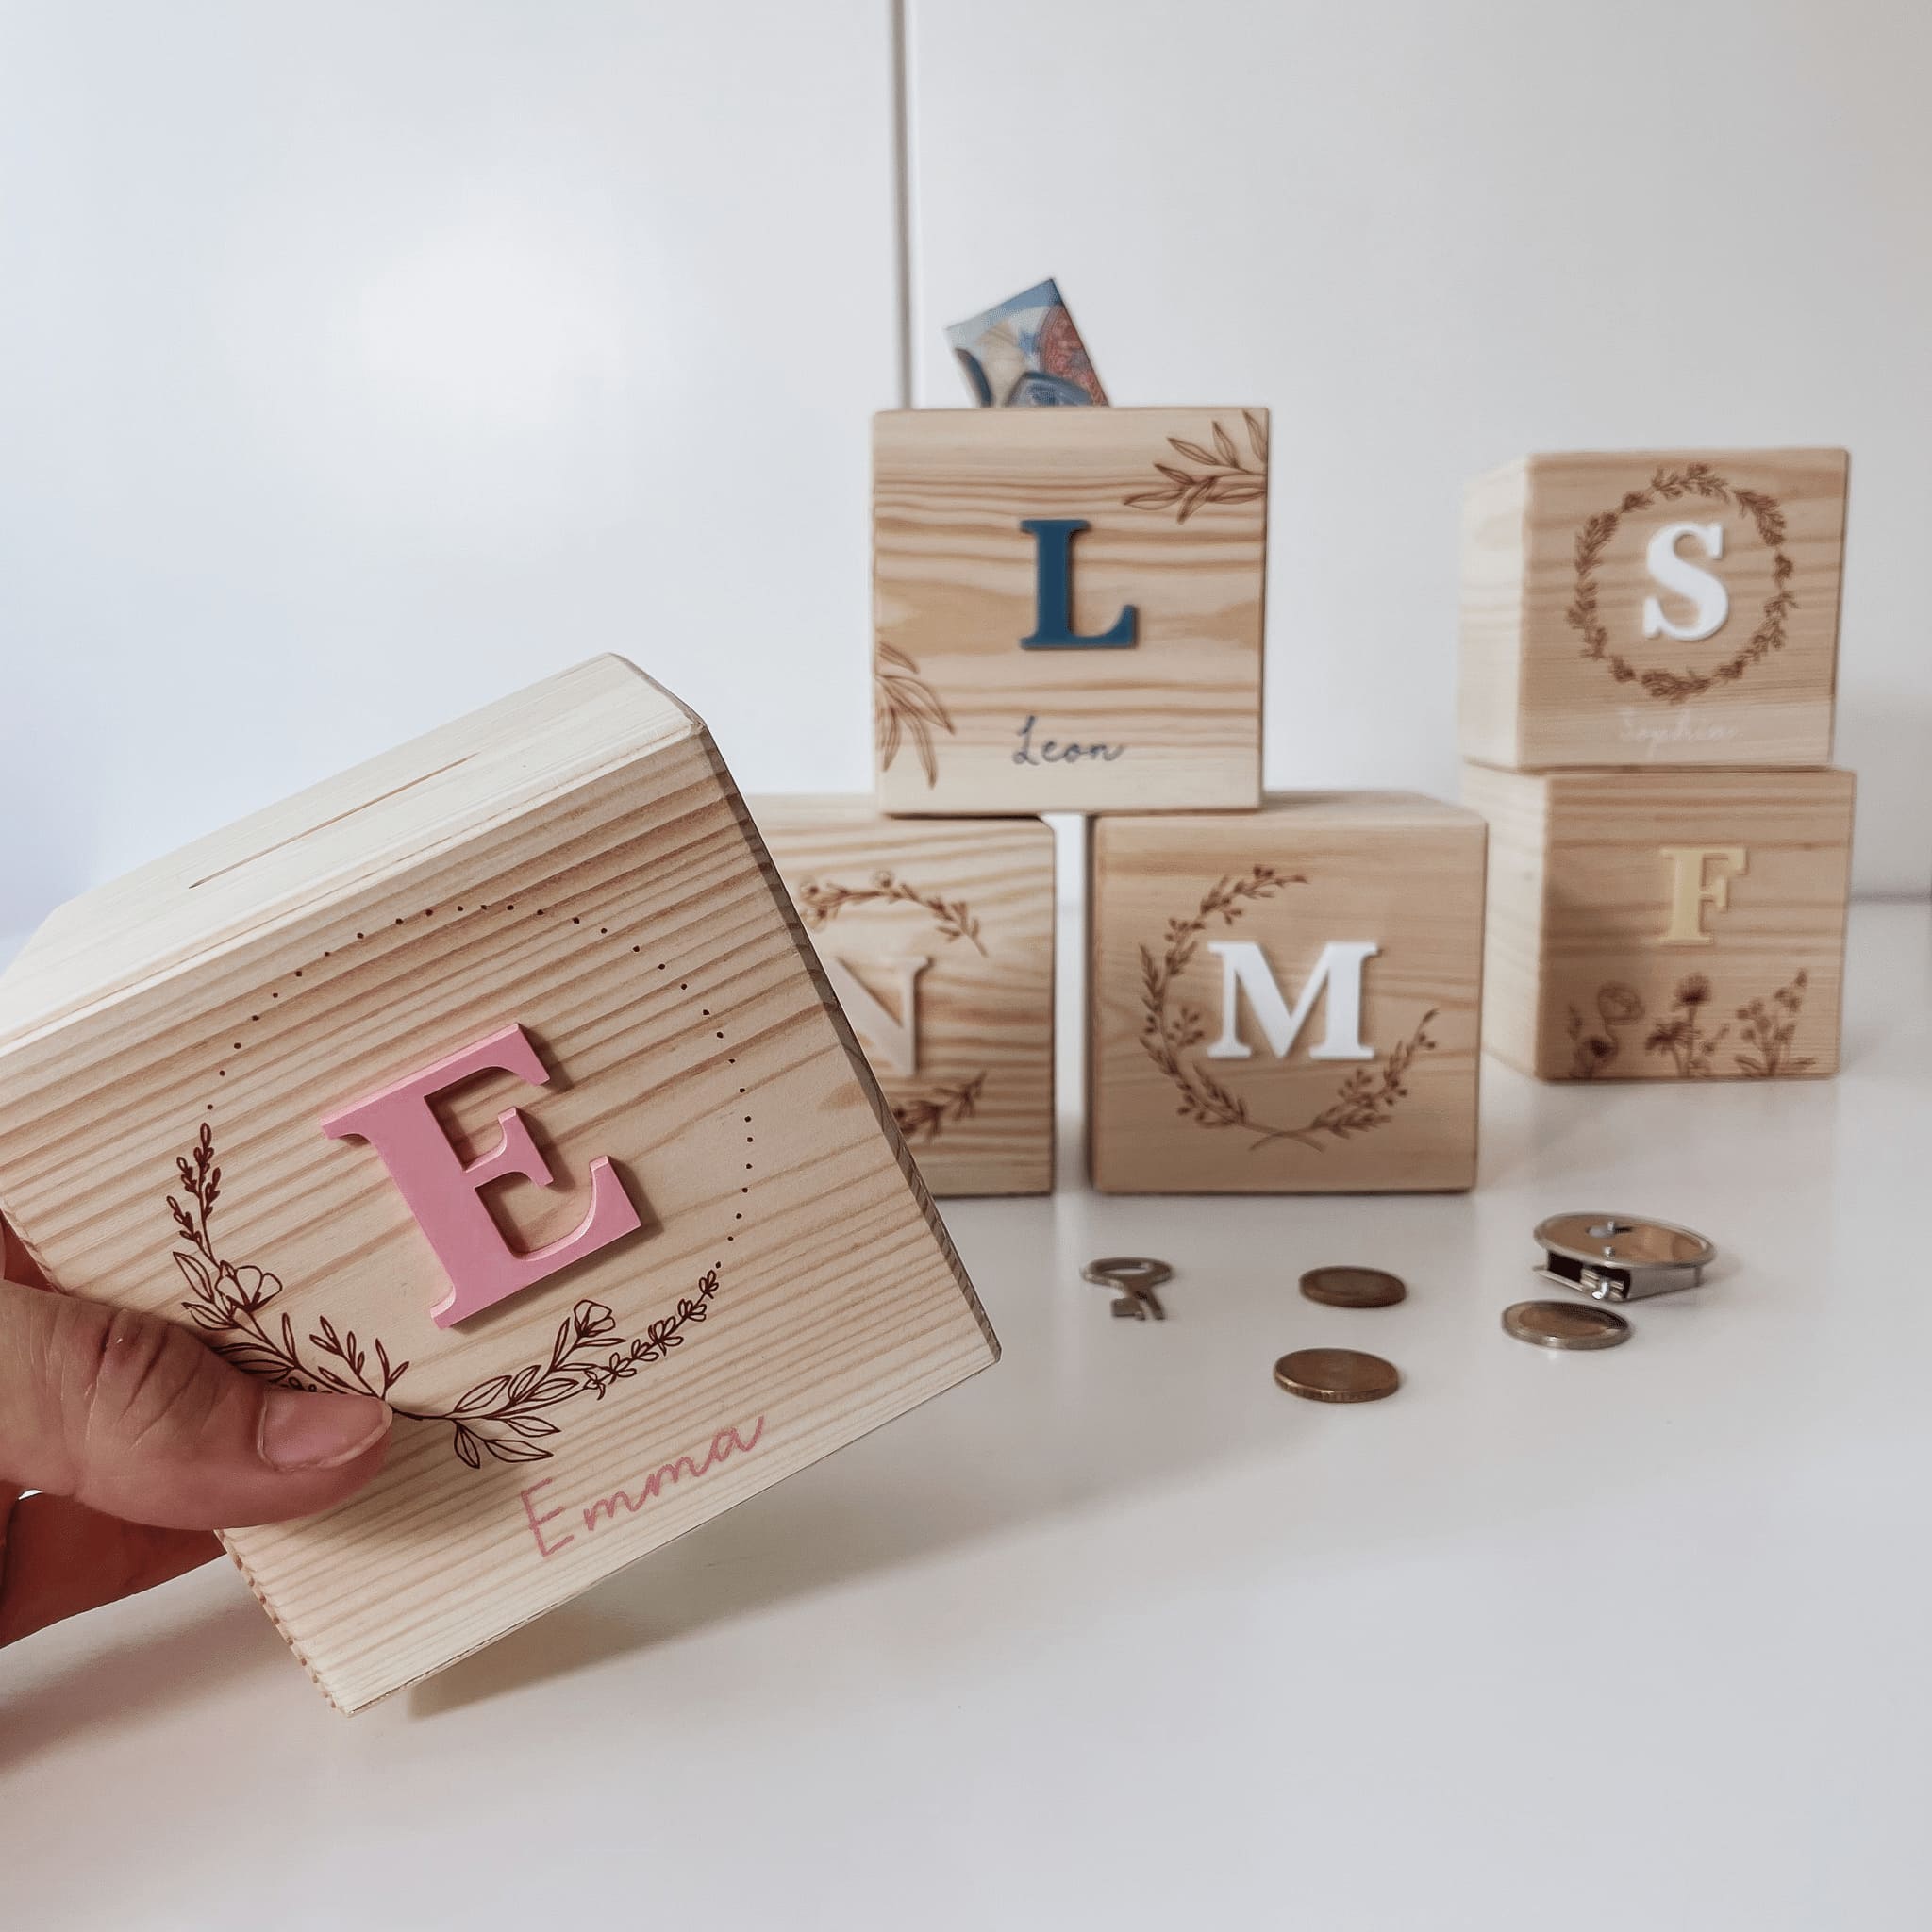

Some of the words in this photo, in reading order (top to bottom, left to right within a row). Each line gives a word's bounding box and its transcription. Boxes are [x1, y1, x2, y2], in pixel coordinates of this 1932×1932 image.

[1019, 518, 1138, 650] L
[1642, 523, 1728, 641] S
[1012, 714, 1125, 766] Leon
[1657, 846, 1747, 945] F
[1207, 941, 1378, 1059] M
[321, 1023, 642, 1329] E
[521, 1415, 765, 1558] Emma
